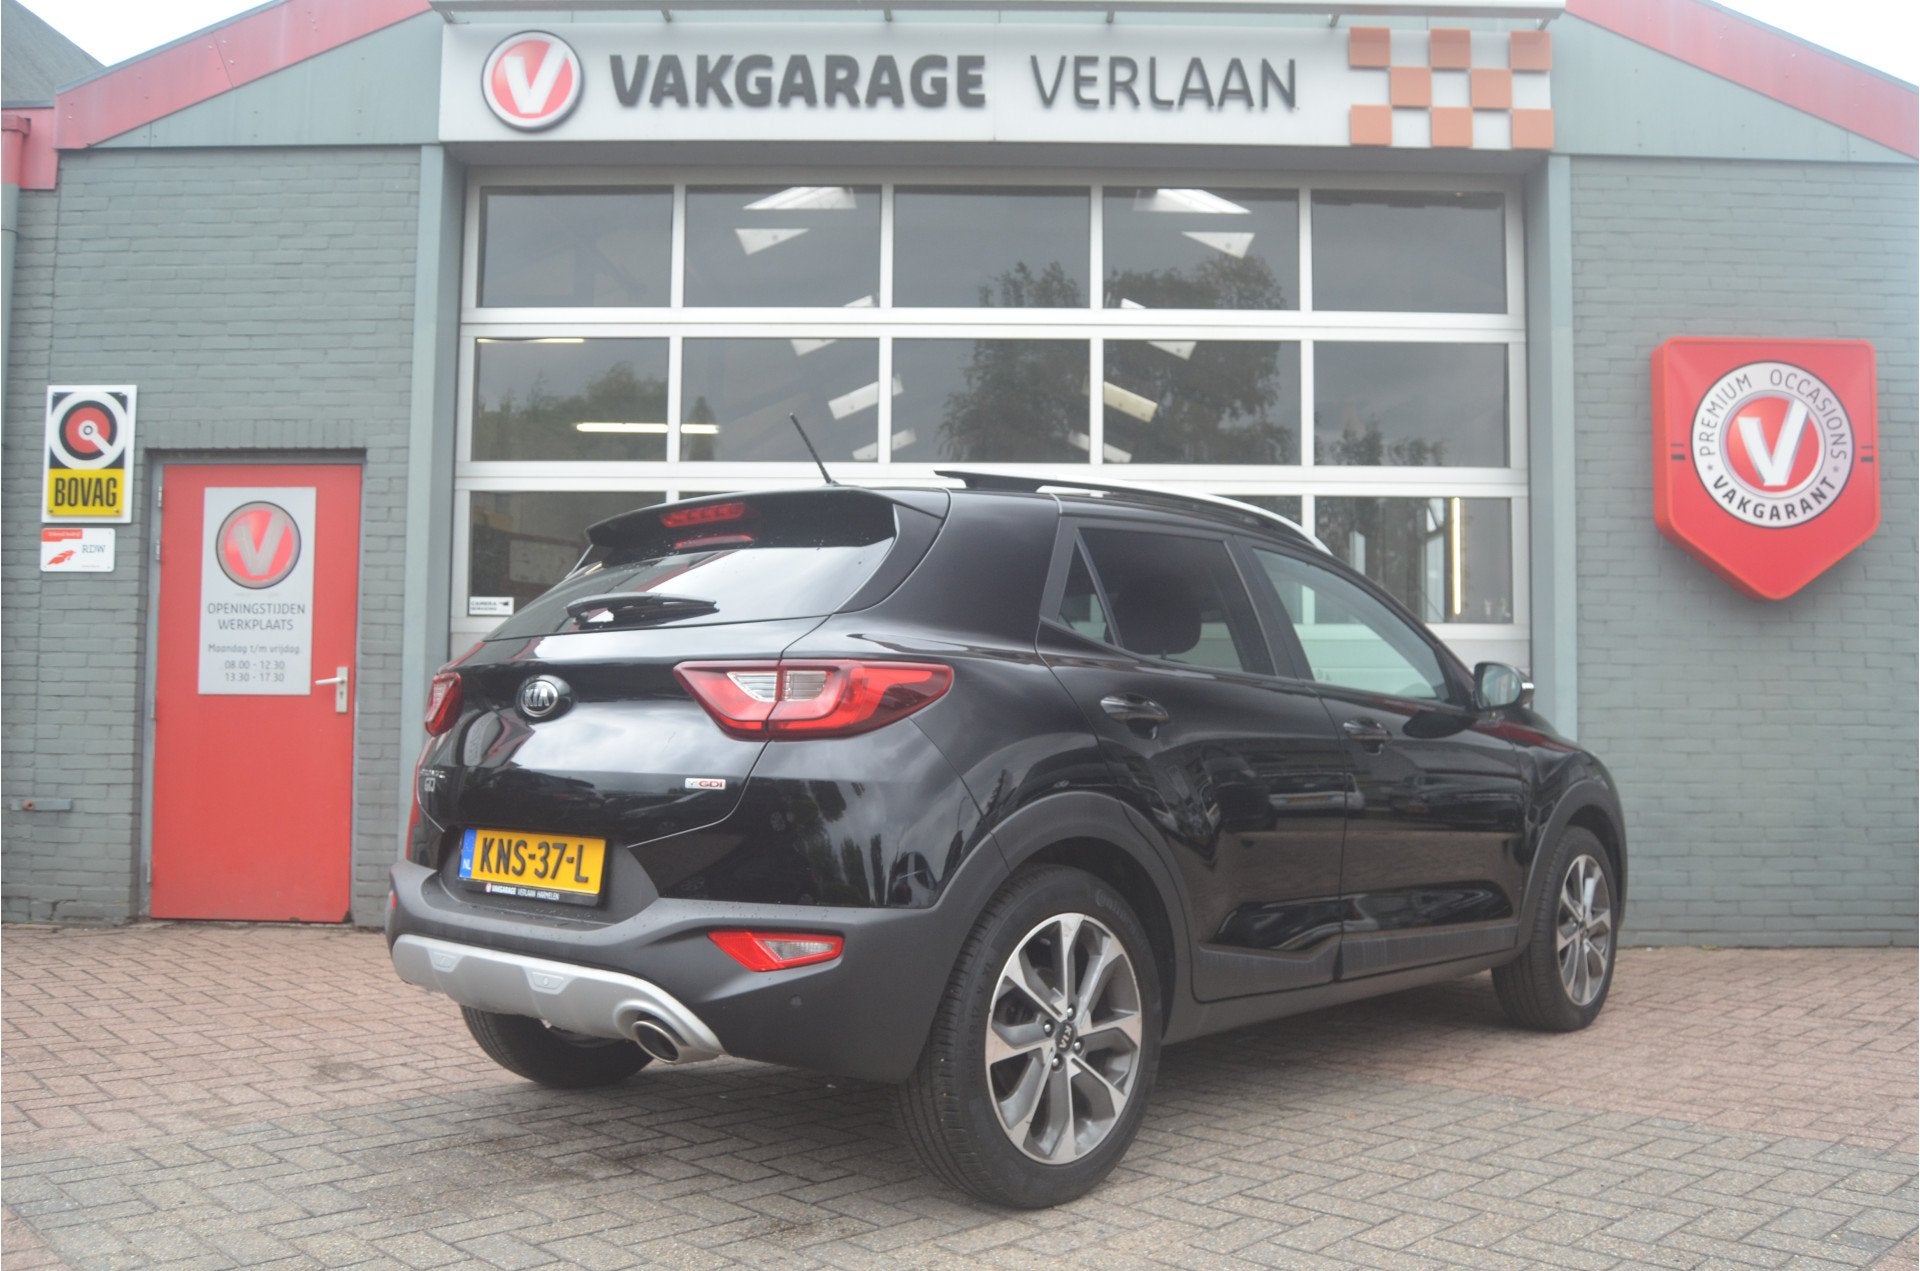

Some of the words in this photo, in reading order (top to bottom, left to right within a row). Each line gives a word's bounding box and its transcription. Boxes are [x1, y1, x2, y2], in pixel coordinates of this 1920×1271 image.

[609, 53, 986, 107] VAKGARAGE
[1030, 54, 1297, 108] VERLAAN
[1699, 372, 1752, 458] PREMIUM
[1769, 367, 1848, 461] OCCASIONS
[53, 476, 118, 507] BOVAG
[1713, 474, 1836, 521] VAKGARANT
[81, 544, 106, 554] RDW
[207, 603, 306, 615] OPENINGSTIJDEN
[218, 619, 294, 631] WERKPLAATS
[208, 644, 247, 654] Maandag
[250, 644, 267, 653] t/m
[269, 644, 300, 655] vrijdag
[524, 688, 551, 707] KIA
[462, 857, 472, 870] NL
[479, 836, 590, 884] KNS-37-L
[1058, 1025, 1073, 1048] KIA
